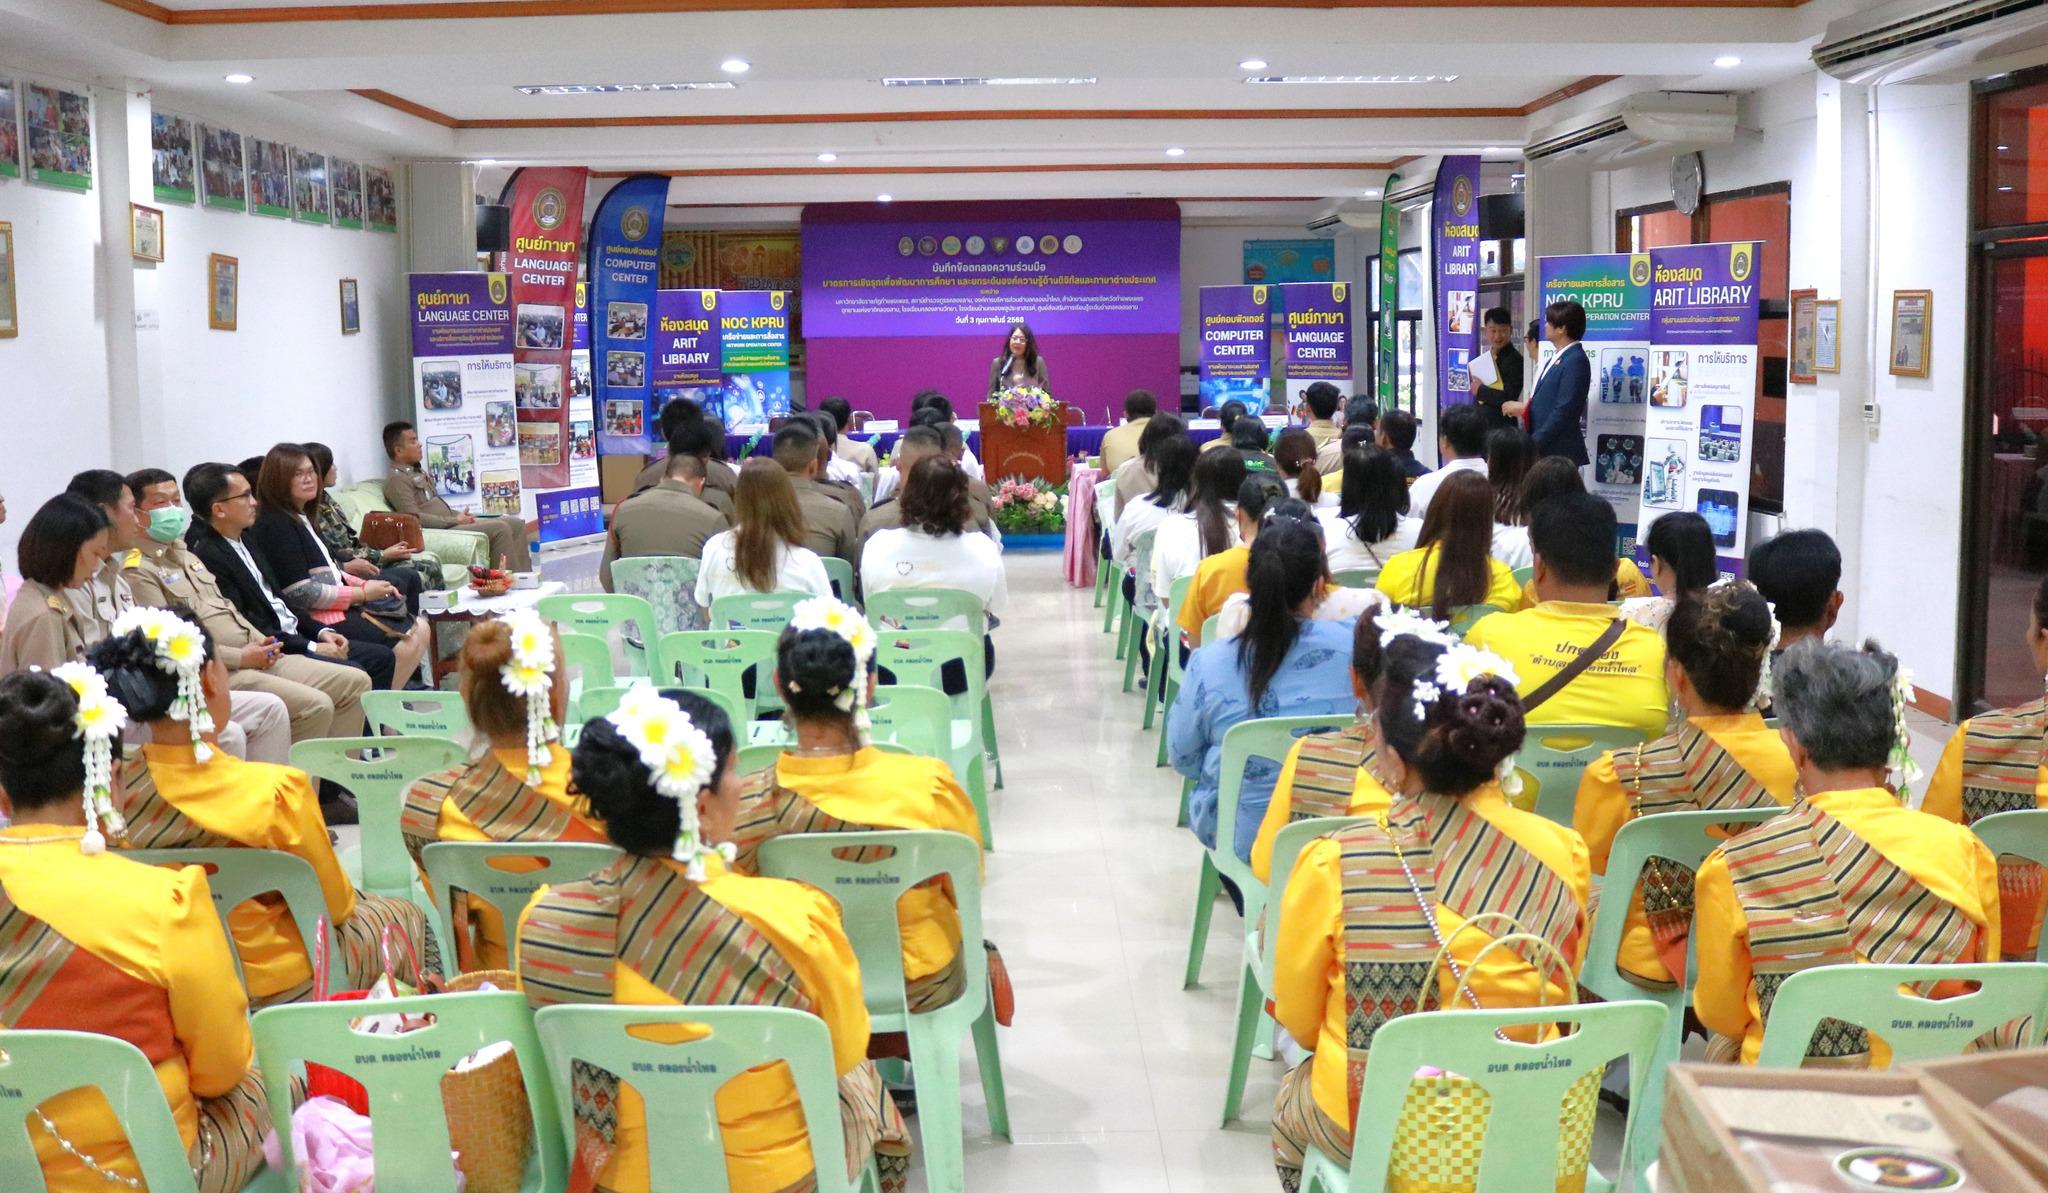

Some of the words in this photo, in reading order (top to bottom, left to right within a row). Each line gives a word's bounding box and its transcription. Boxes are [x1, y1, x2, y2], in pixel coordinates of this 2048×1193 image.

[516, 236, 575, 253] ศูนย์ภาษา
[1453, 245, 1471, 257] ARIT
[514, 258, 573, 272] LANGUAGE
[605, 258, 656, 270] COMPUTER
[932, 261, 1046, 272] บันทึกข้อตกลงความร่วมมือ
[522, 273, 565, 285] CENTER
[612, 273, 648, 283] CENTER
[1655, 264, 1702, 286] ห้องสมุด
[1546, 275, 1625, 288] เครือข่ายและการสื่อสาร
[418, 289, 470, 309] ศูนย์ภาษา
[1582, 292, 1624, 308] KPRU
[1654, 287, 1685, 306] ARIT
[1687, 285, 1752, 305] LIBRARY
[418, 311, 470, 321] LANGUAGE
[473, 310, 509, 321] CENTER
[956, 314, 968, 324] วันที่
[975, 315, 1006, 325] กุมภาพันธ์
[1205, 313, 1264, 327] ศูนย์คอมพิวเตอร์
[1288, 308, 1344, 329] ศูนย์ภาษา
[1585, 313, 1619, 321] PERATION
[660, 316, 709, 335] ห้องสมุด
[721, 317, 748, 329] NOC
[751, 317, 784, 329] KPRU
[1205, 330, 1264, 342] COMPUTER
[1289, 331, 1344, 343] LANGUAGE
[672, 337, 698, 349] ARIT
[1213, 344, 1254, 356] CENTER
[1297, 347, 1336, 358] CENTER
[662, 353, 710, 365] LIBRARY
[1698, 351, 1747, 364] การให้บริการ
[468, 359, 512, 370] การให้บริการ
[1891, 1019, 1914, 1029] อบต.
[1917, 1012, 1974, 1030] คลองน้ำไหล
[355, 1054, 379, 1064] อบต.
[381, 1044, 441, 1062] คลองน้ำไหล
[1487, 1063, 1511, 1073] อบต.
[1514, 1053, 1572, 1071] คลองน้ำไหล
